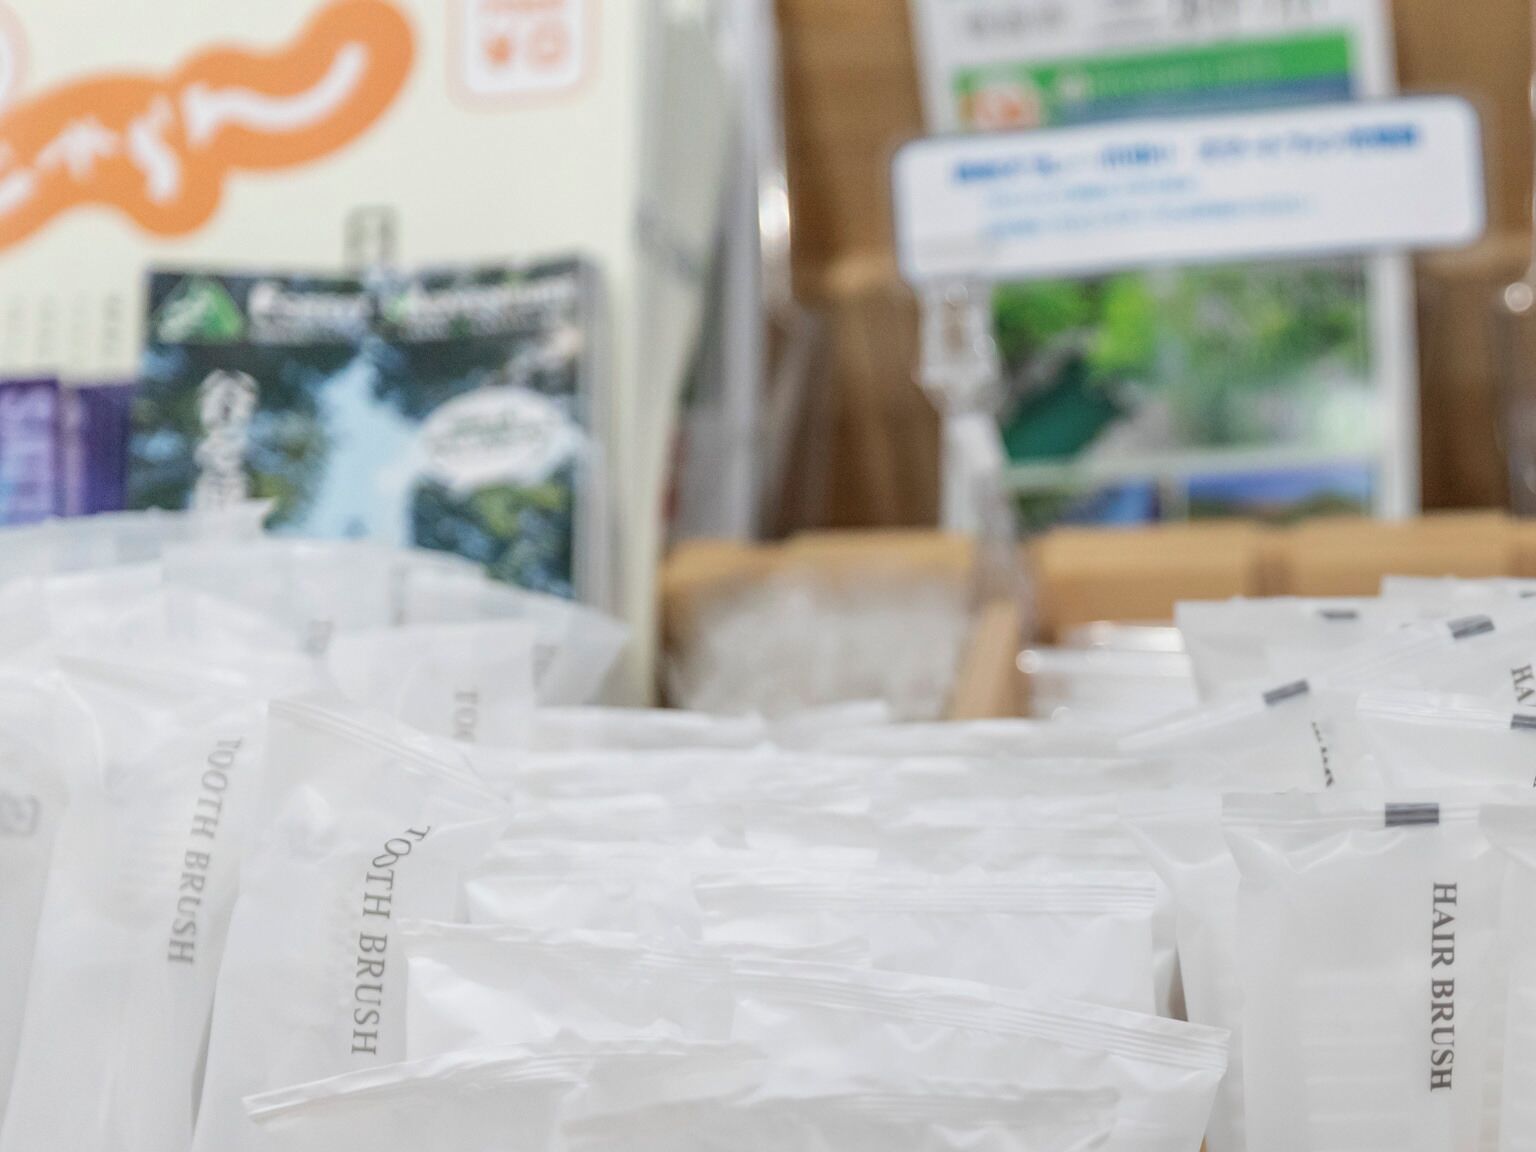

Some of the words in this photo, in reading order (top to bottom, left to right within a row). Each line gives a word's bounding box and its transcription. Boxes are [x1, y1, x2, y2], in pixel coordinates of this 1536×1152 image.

[167, 850, 210, 965] BRUSH
[1431, 882, 1457, 969] HAIR
[351, 932, 388, 1056] BRUSH
[1430, 978, 1455, 1092] BRUSH
